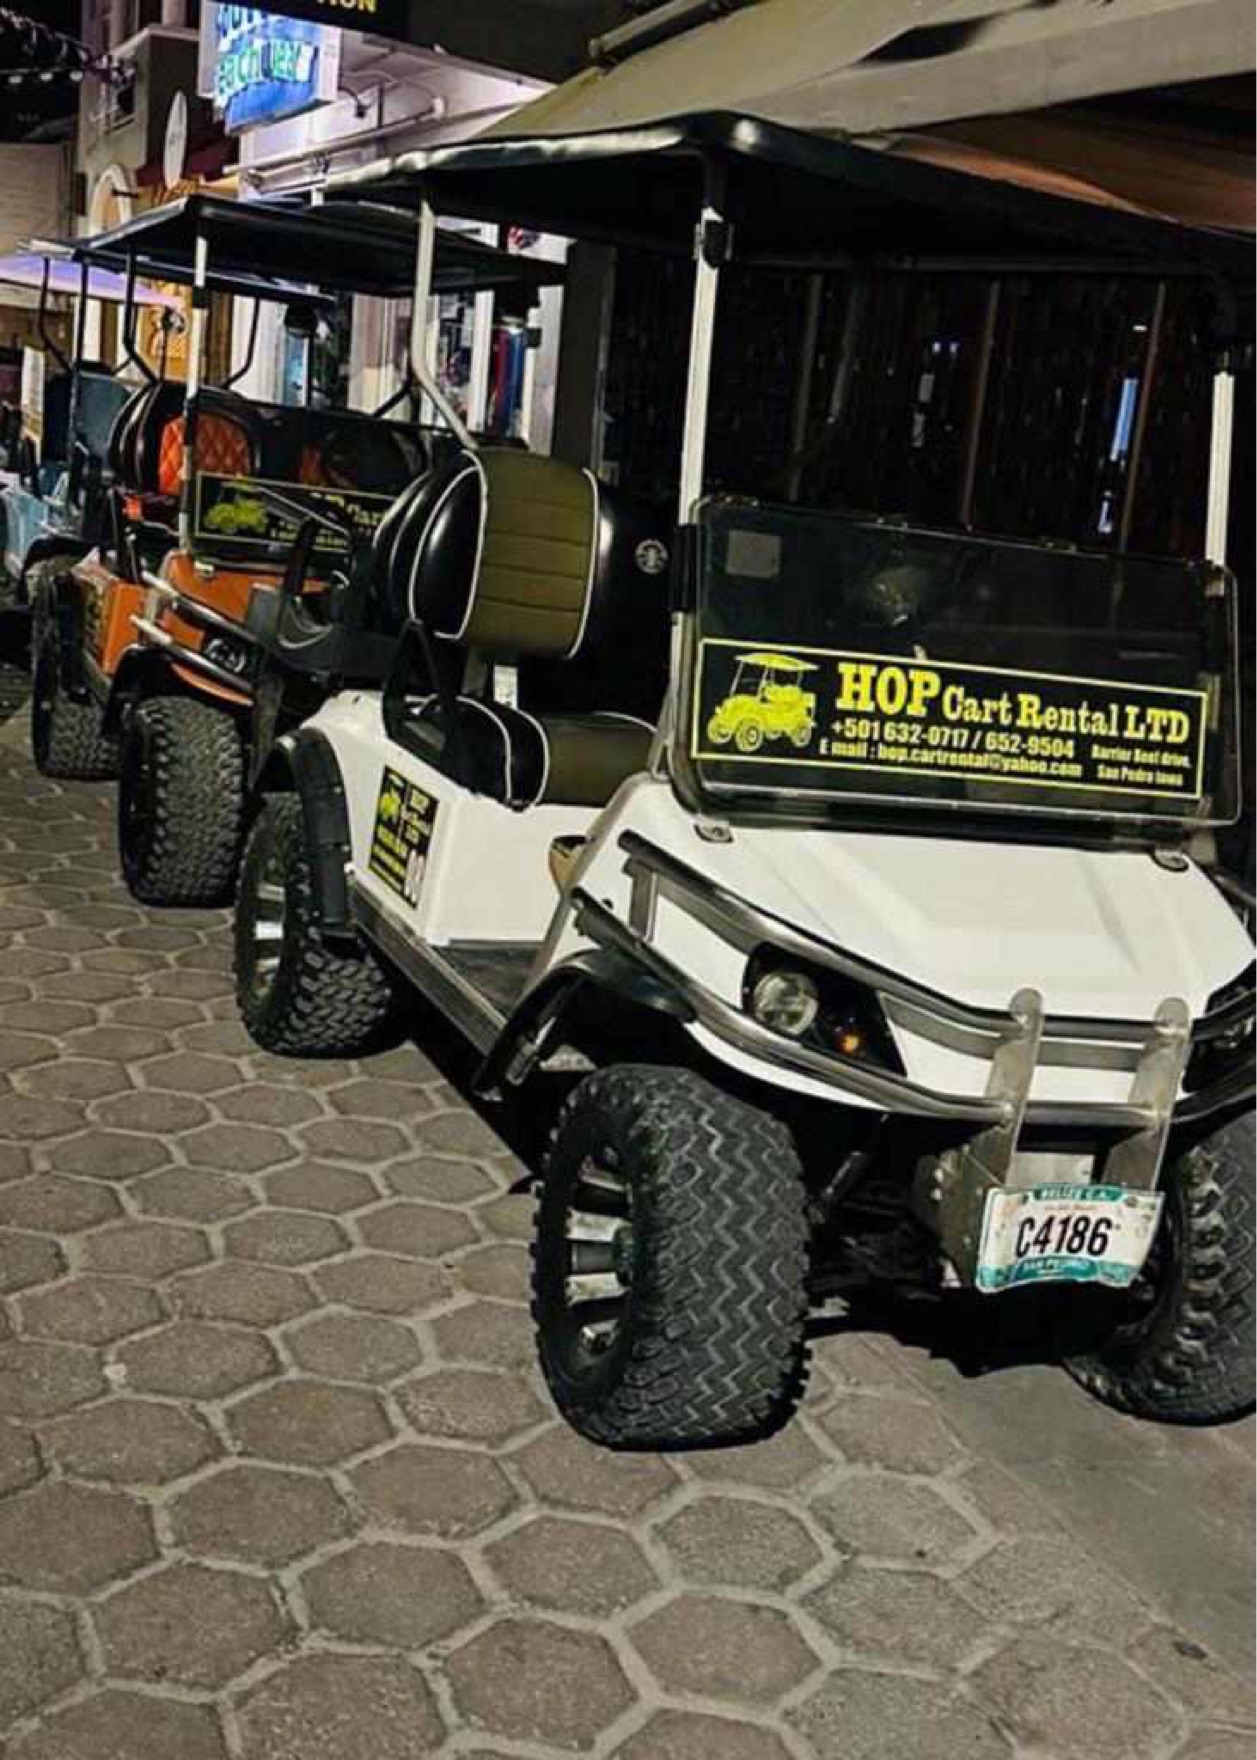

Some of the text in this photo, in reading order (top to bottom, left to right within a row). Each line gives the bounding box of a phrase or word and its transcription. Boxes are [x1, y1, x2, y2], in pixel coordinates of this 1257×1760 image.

[835, 662, 1190, 743] HOP Cart Rental LTD
[831, 718, 1075, 759] +501 632-0717 / 652-9504
[1015, 1214, 1113, 1258] C4186
